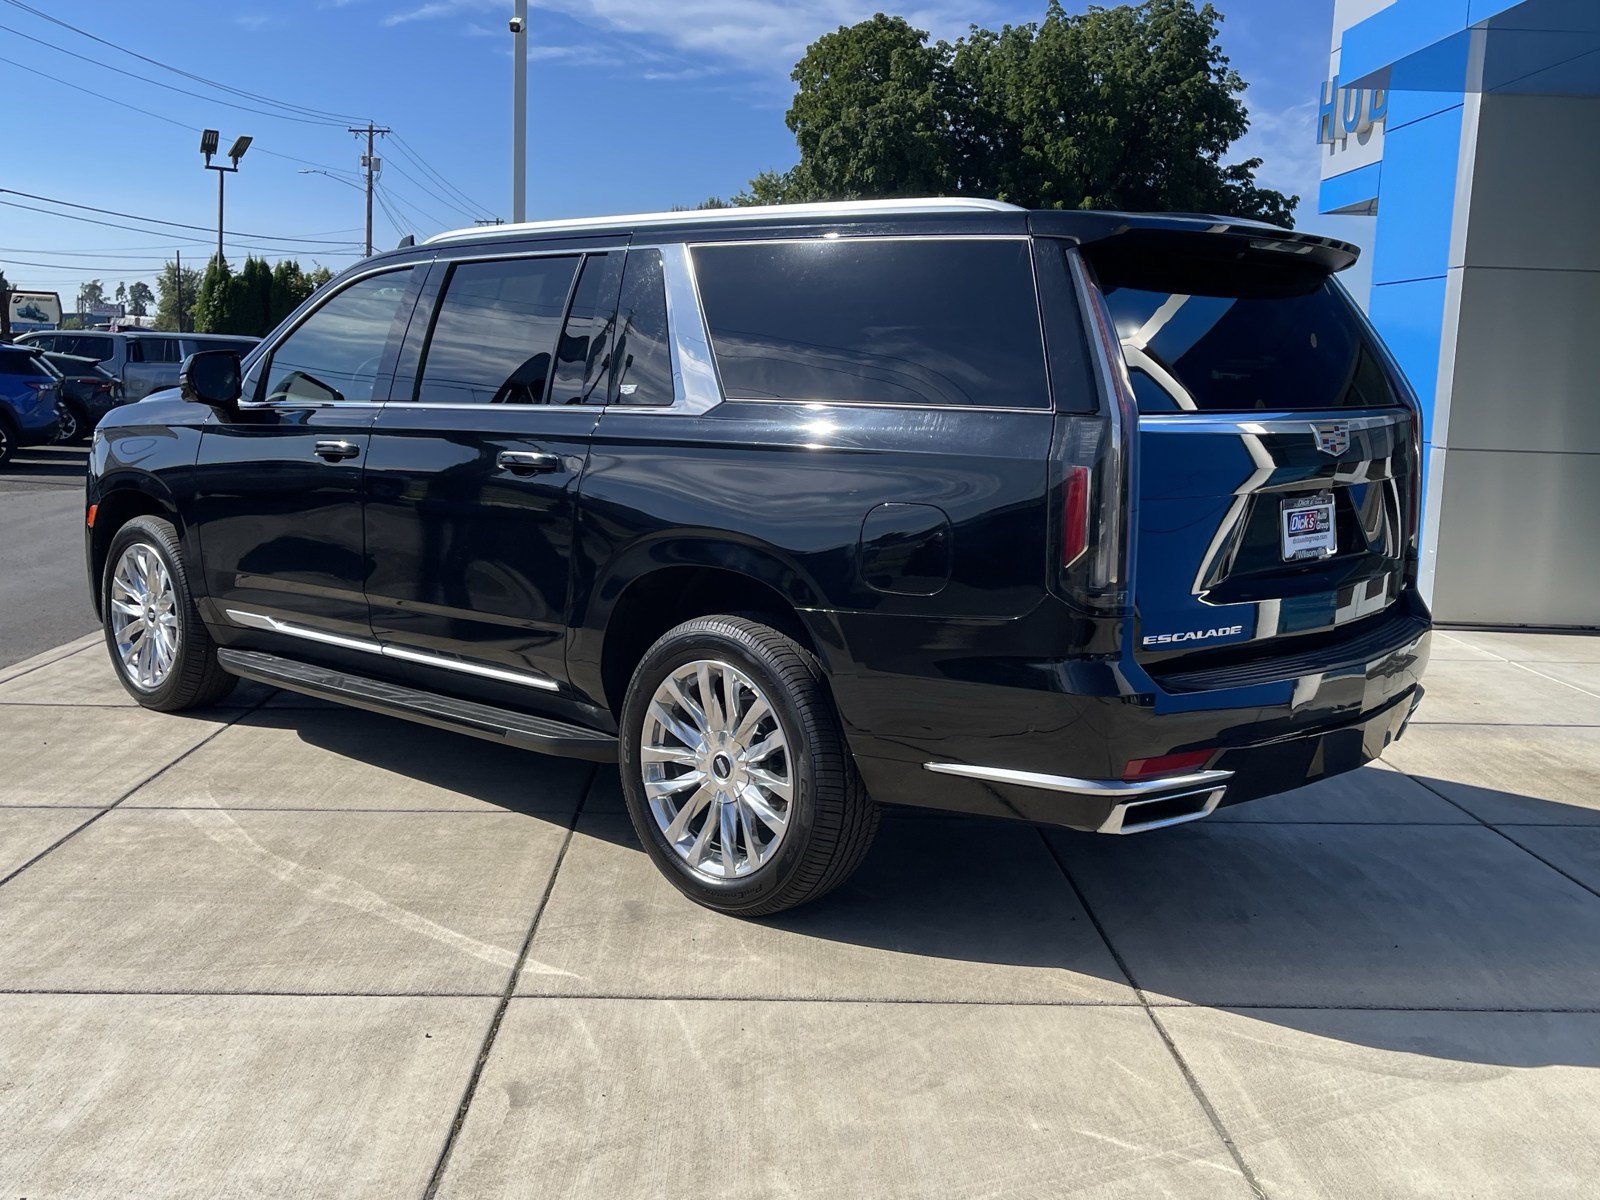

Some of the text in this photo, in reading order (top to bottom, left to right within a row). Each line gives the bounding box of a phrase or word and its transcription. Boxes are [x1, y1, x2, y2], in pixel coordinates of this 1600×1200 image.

[1291, 514, 1315, 530] Dick's
[1316, 521, 1329, 530] Group
[1142, 625, 1242, 645] ESCALADE
